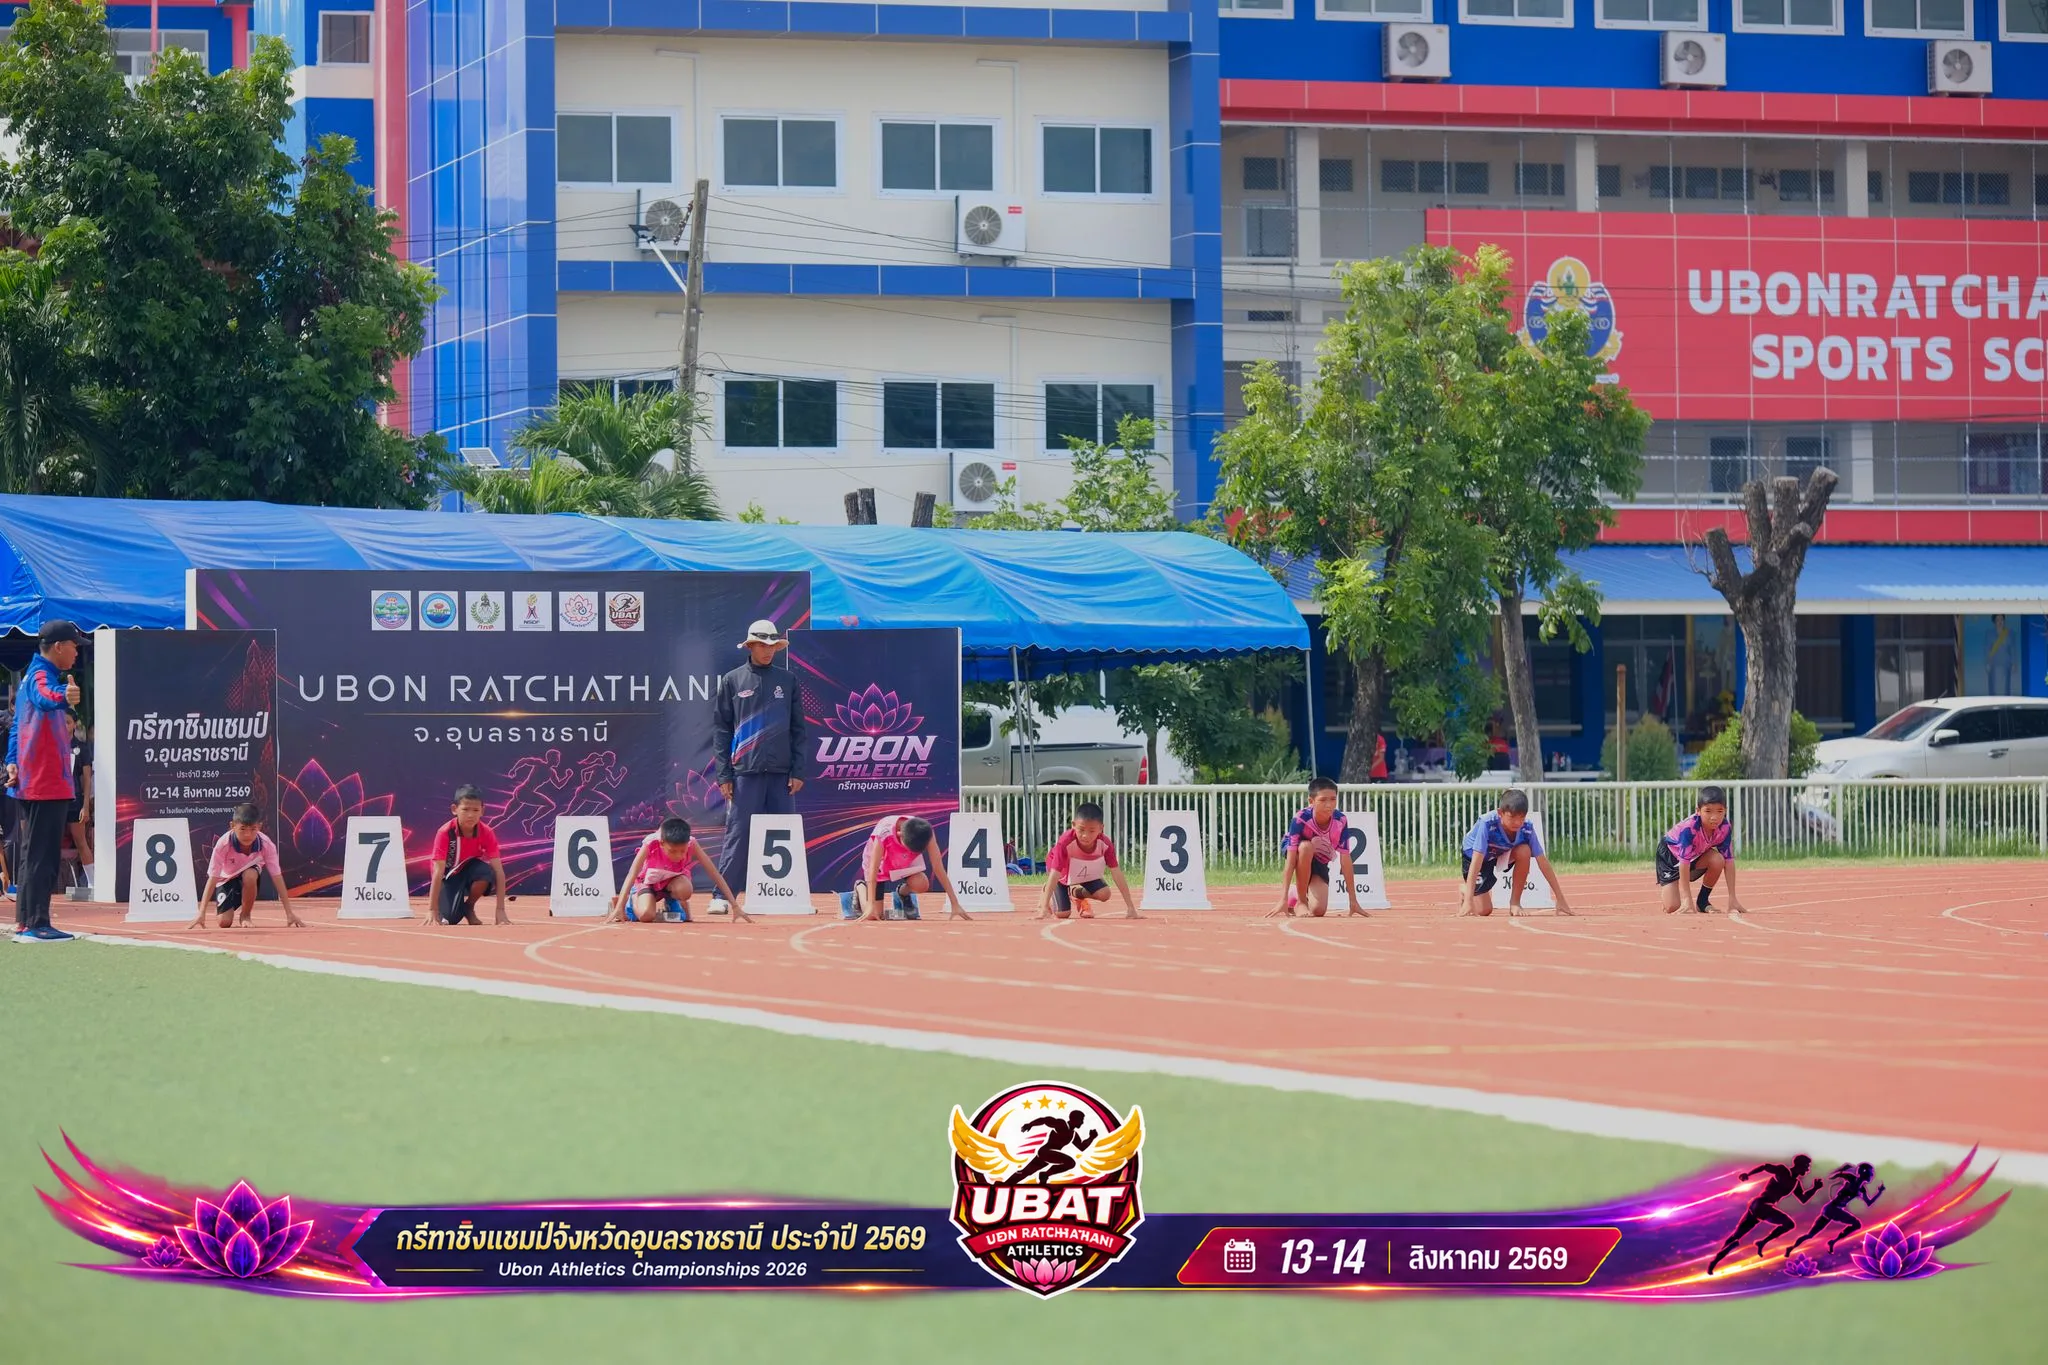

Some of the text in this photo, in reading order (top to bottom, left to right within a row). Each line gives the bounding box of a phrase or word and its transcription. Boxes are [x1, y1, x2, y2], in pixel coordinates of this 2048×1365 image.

[1688, 269, 2048, 320] UBONRATCHA
[1752, 333, 2048, 382] SPORTS SC
[299, 674, 722, 702] UBON RATCHATHANI
[127, 711, 269, 741] กรีฑาชิงแชมป์
[414, 720, 608, 751] จ.อุบลราชธานี
[144, 742, 249, 768] จ.อุบลราชธานี
[816, 735, 938, 762] UBON
[202, 770, 220, 778] 2569
[816, 763, 932, 779] ATHLETICS
[183, 785, 222, 798] สิงหาคม
[225, 785, 251, 797] 2569
[145, 833, 177, 885] 8
[358, 832, 390, 883] 7
[567, 828, 599, 879] 6
[762, 829, 793, 879] 5
[961, 828, 992, 878] 4
[1159, 825, 1189, 874] 3
[1340, 827, 1369, 875] 2
[1077, 865, 1089, 879] 4
[141, 888, 181, 903] Nelco
[354, 886, 393, 901] Nelco
[563, 882, 600, 897] Nelco
[757, 882, 794, 897] Nelco
[957, 880, 993, 896] Nelco
[1336, 880, 1370, 893] Nco
